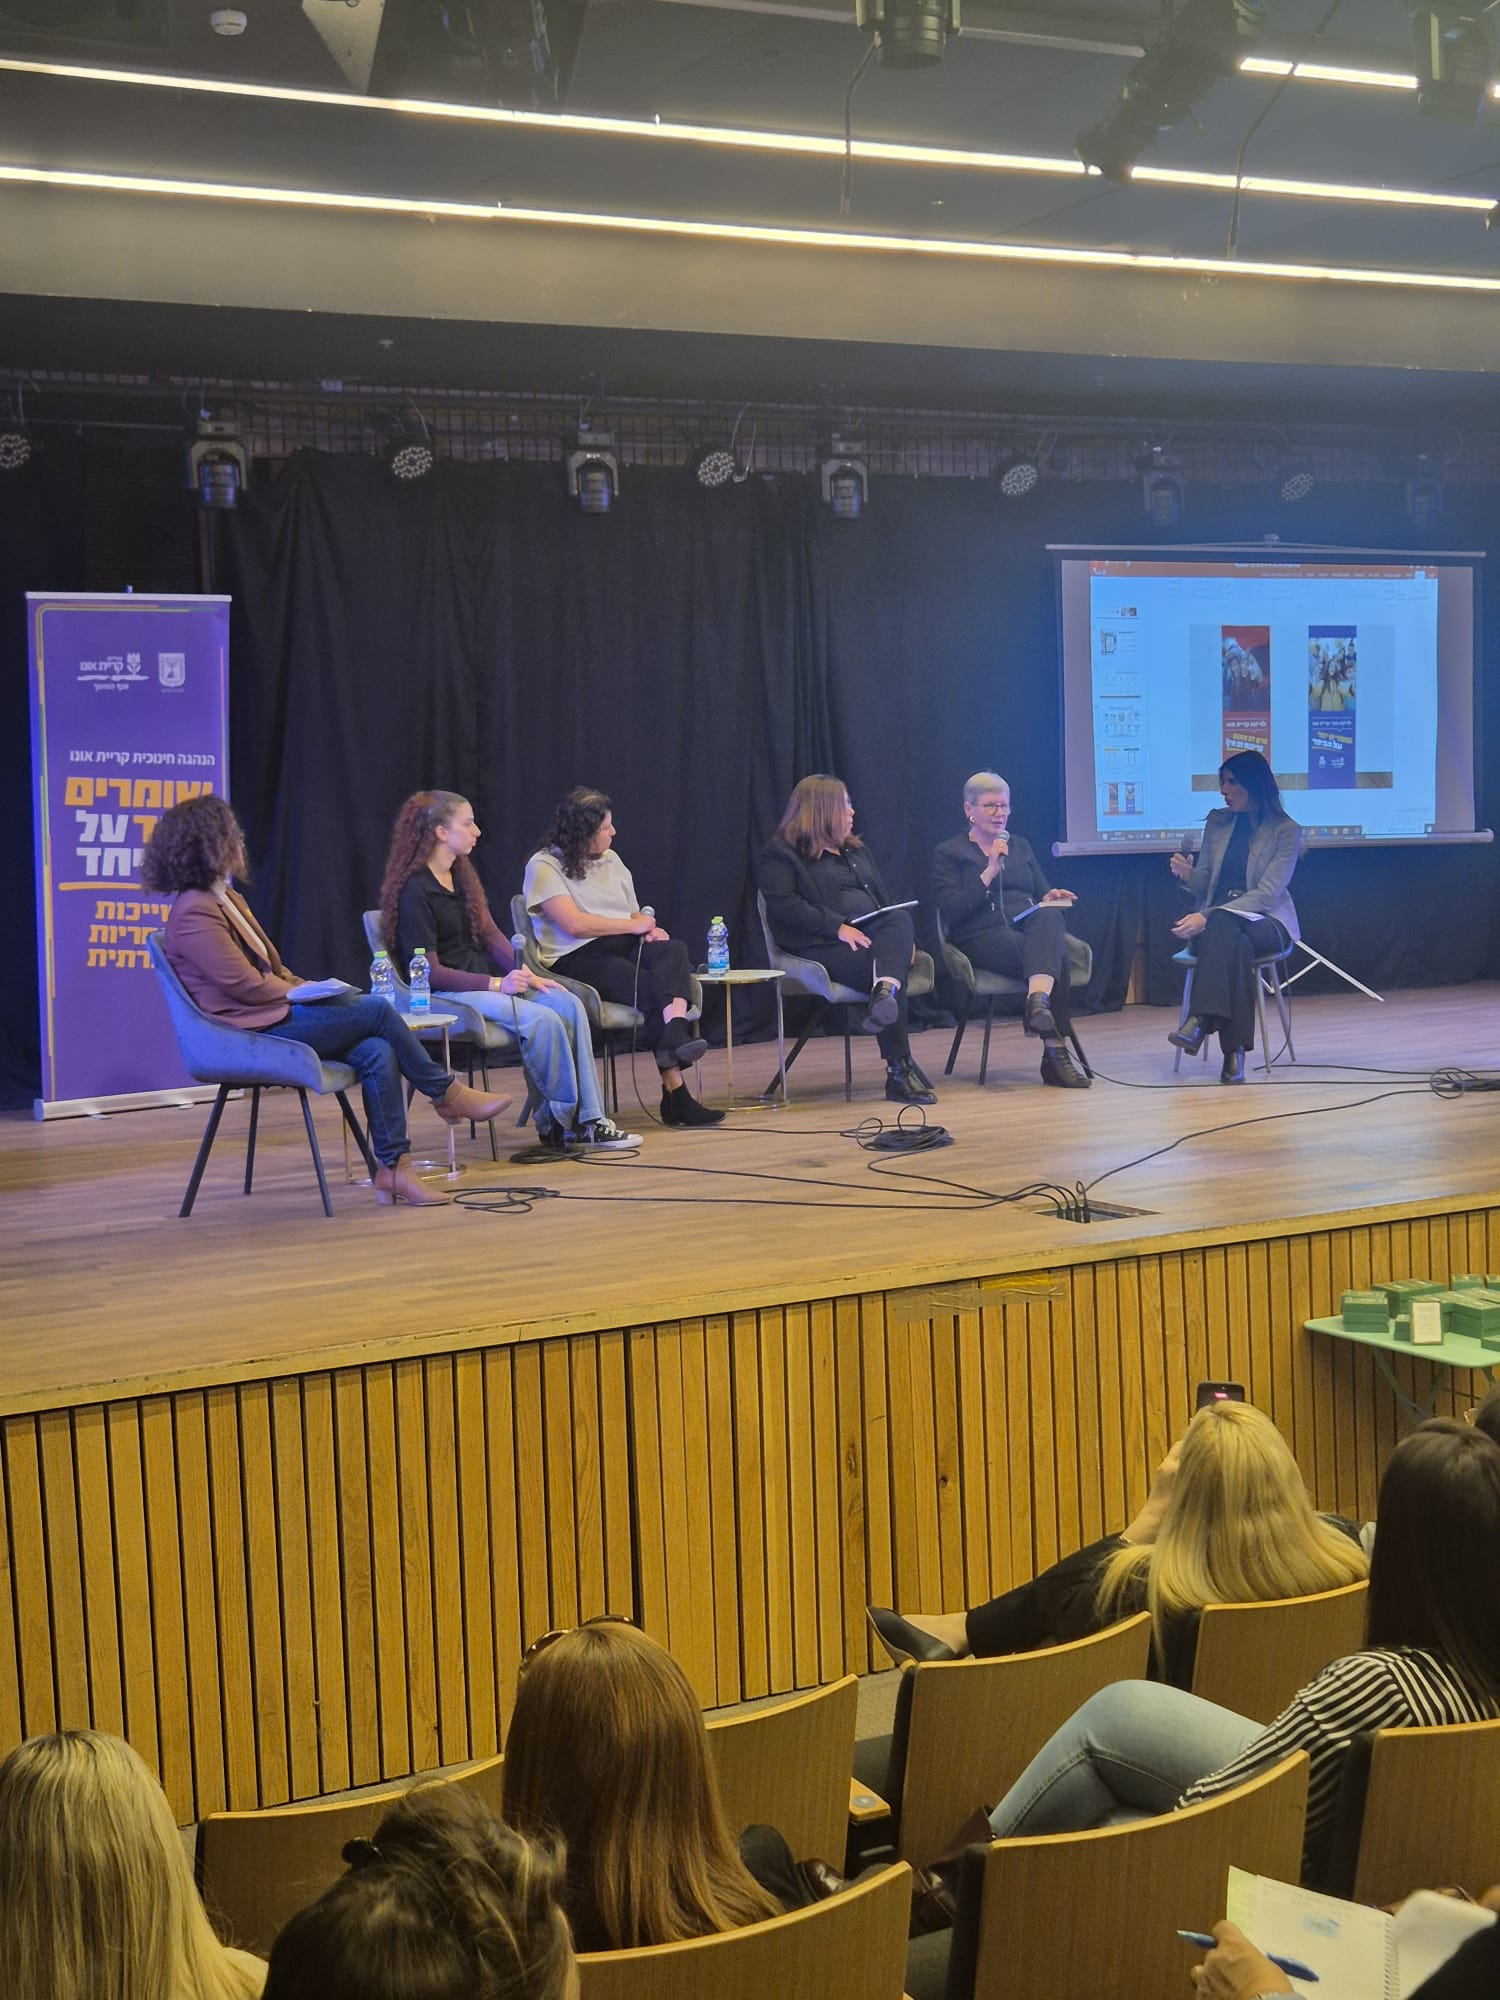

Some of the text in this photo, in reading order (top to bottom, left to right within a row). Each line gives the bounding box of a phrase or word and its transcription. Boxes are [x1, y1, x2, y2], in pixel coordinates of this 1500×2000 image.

[70, 750, 215, 766] הנהגה חינוכית קריית אונו
[75, 810, 129, 843] על
